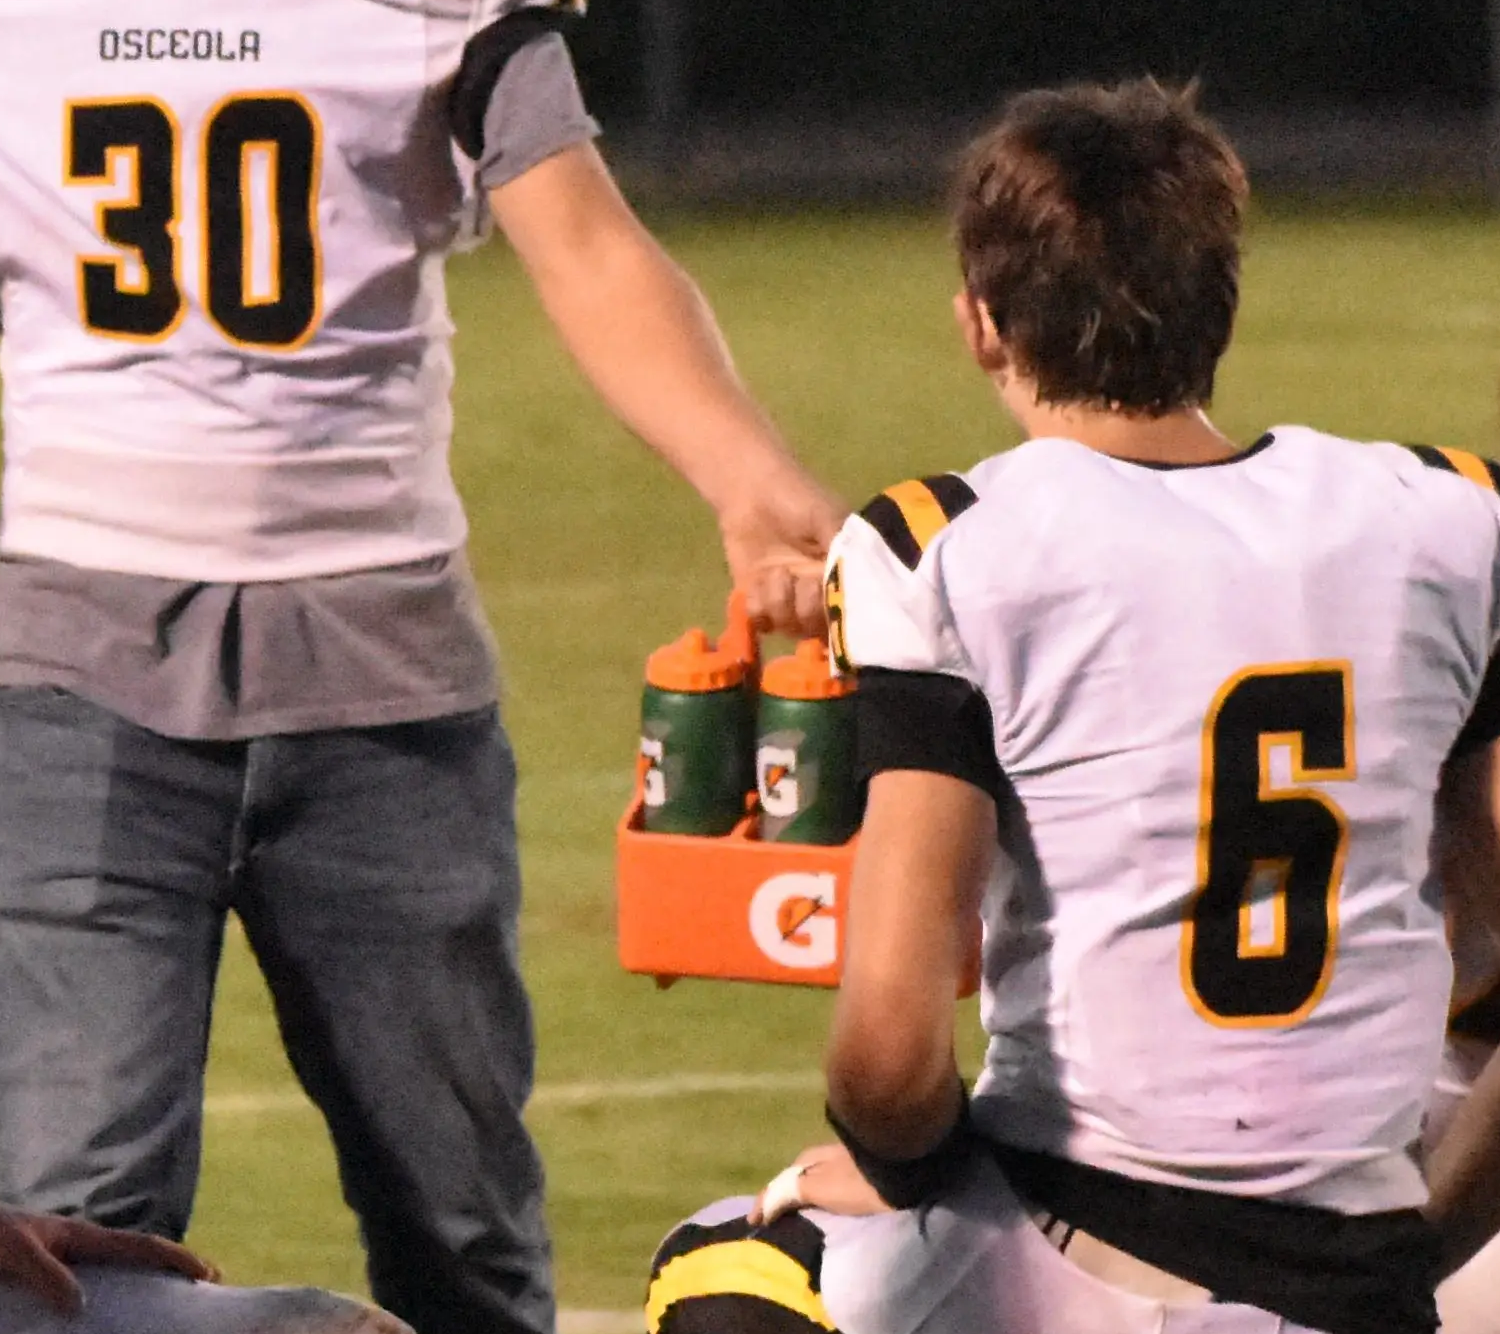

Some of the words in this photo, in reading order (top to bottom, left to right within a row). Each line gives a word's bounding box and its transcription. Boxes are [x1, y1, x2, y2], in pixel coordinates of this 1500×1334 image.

[98, 27, 263, 65] OSCEOLA
[62, 89, 324, 352] 30
[748, 871, 838, 968] G
[1179, 660, 1355, 1029] 6
